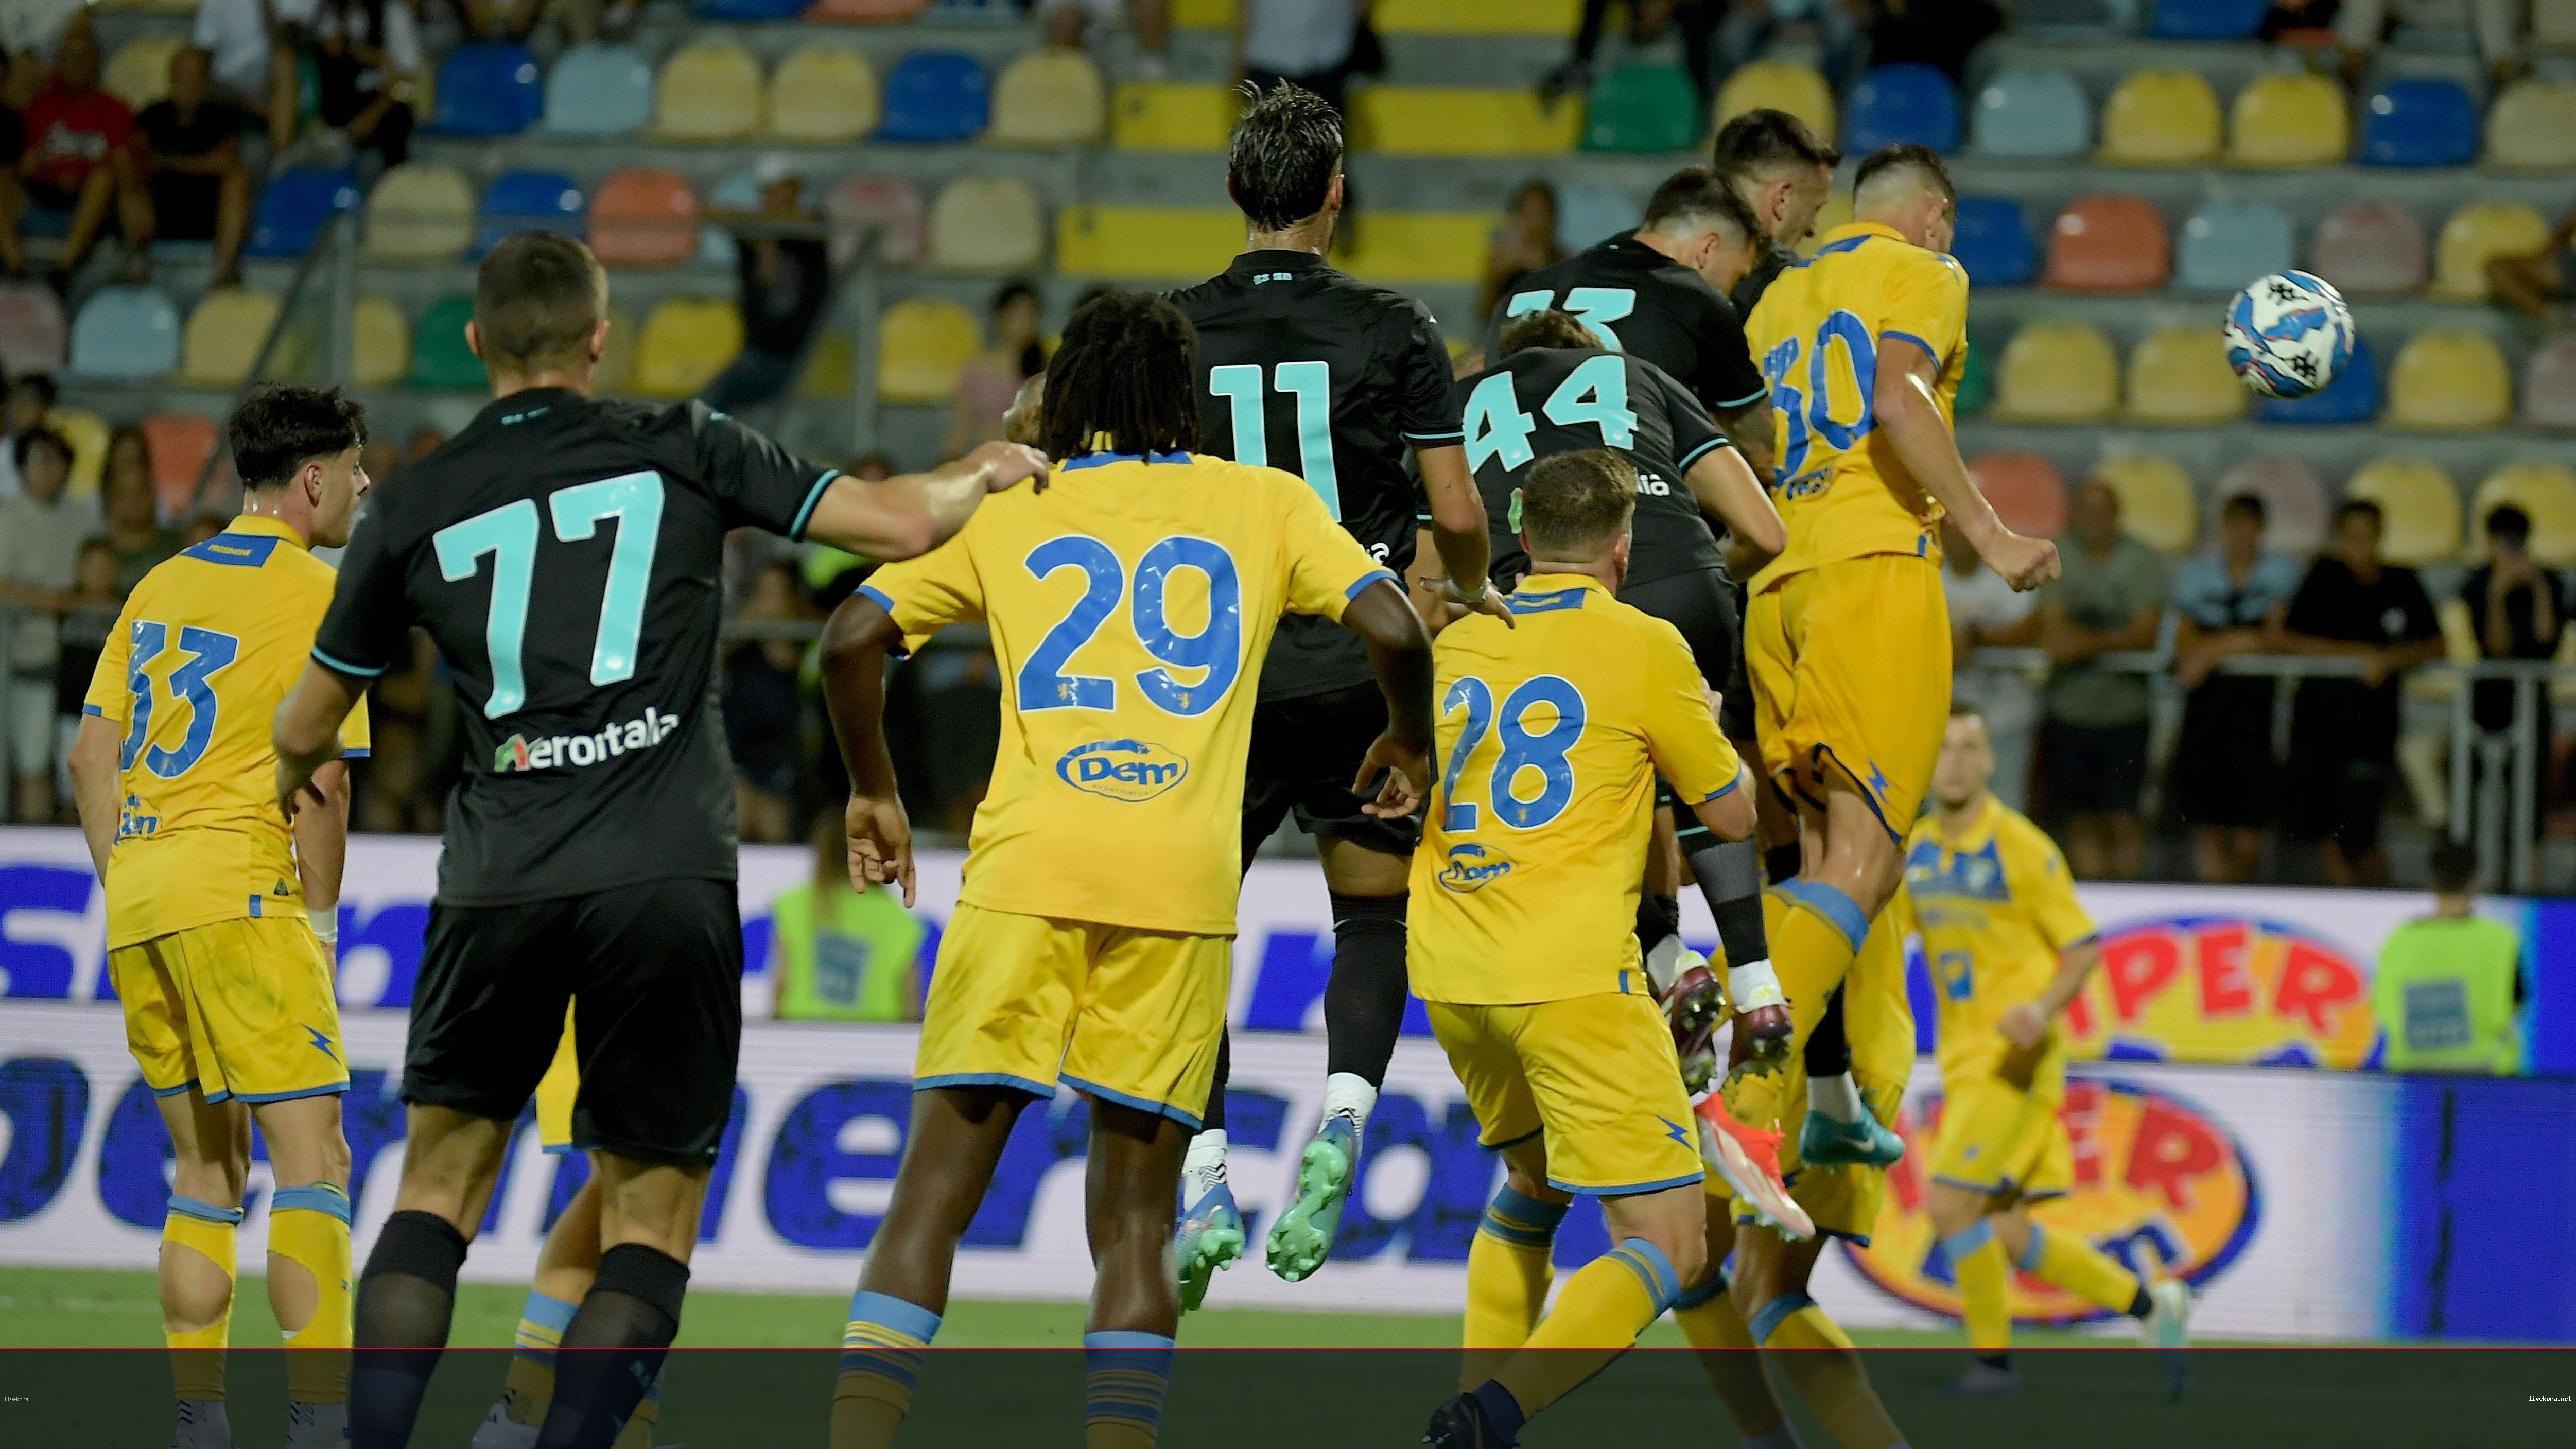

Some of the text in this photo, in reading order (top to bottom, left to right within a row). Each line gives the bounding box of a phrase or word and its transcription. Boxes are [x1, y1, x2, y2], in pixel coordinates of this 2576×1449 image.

[1210, 361, 1342, 523] 11
[1463, 355, 1639, 475] 44
[432, 470, 665, 720] 77
[1017, 534, 1242, 717] 29
[1078, 756, 1178, 785] Dem
[1443, 673, 1587, 831] 28
